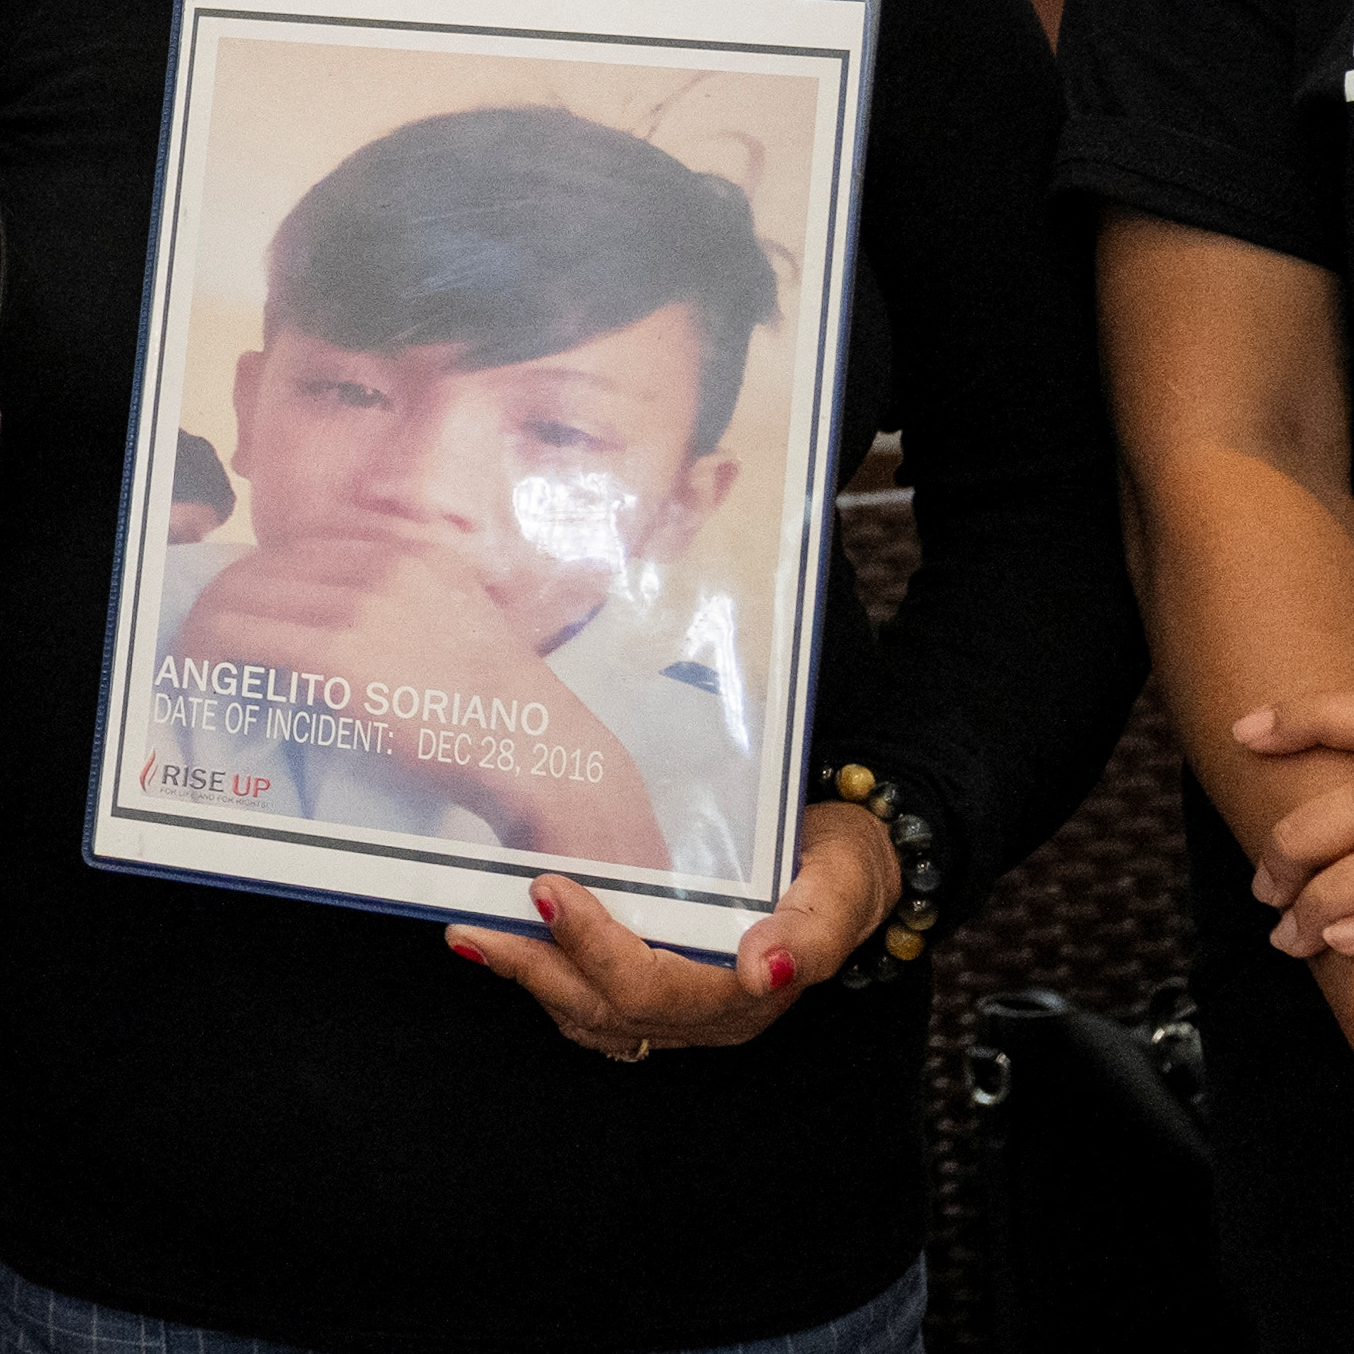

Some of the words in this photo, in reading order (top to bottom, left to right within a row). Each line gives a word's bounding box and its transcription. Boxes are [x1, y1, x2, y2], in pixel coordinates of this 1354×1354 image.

[153, 654, 352, 711] ANGELITO
[364, 681, 550, 736] SORIANO
[153, 693, 217, 731] DATE
[224, 702, 259, 735] OF
[266, 706, 393, 755] INCIDENT:
[418, 728, 470, 765] DEC
[481, 736, 522, 778] 28,
[530, 743, 604, 784] 2016
[161, 764, 226, 793] RISE
[232, 773, 271, 798] UP
